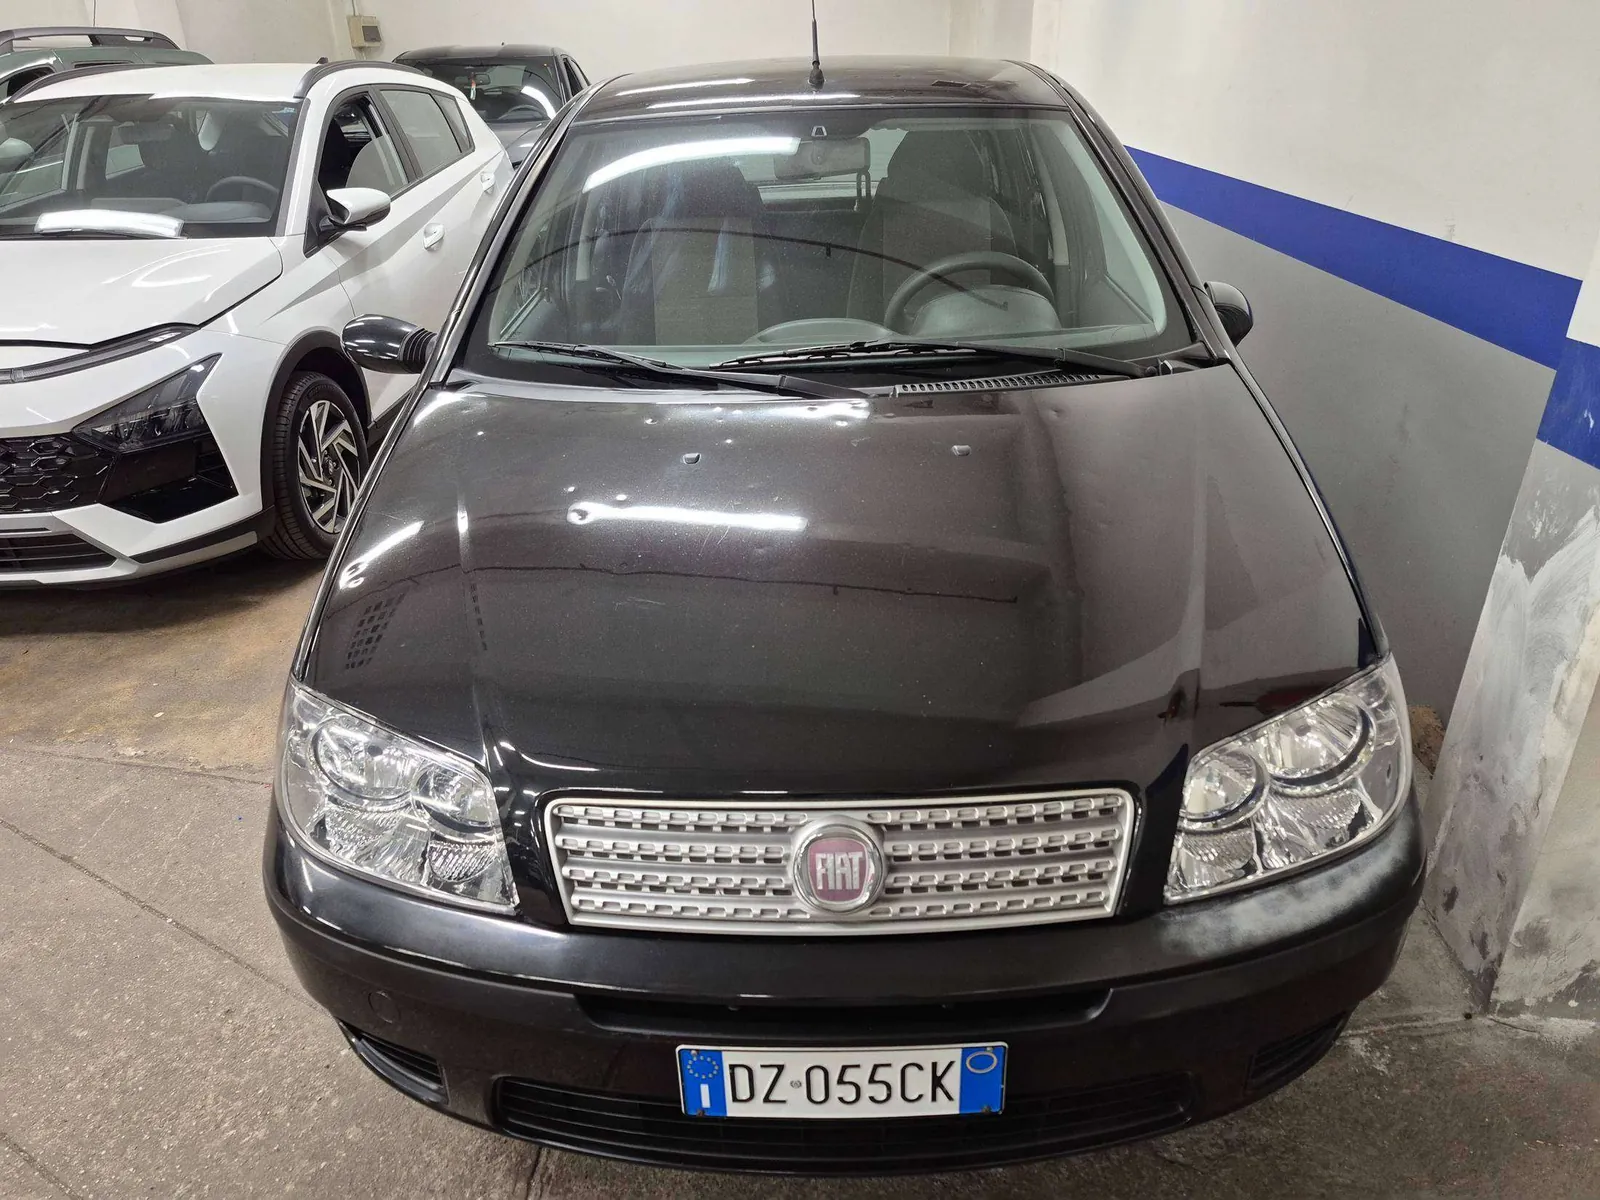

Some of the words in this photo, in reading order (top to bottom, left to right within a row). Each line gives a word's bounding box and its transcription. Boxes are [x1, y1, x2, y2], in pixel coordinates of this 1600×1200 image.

[815, 851, 863, 890] FIAT
[700, 1084, 711, 1108] I
[728, 1063, 787, 1104] DZ
[804, 1060, 956, 1105] 055CK
